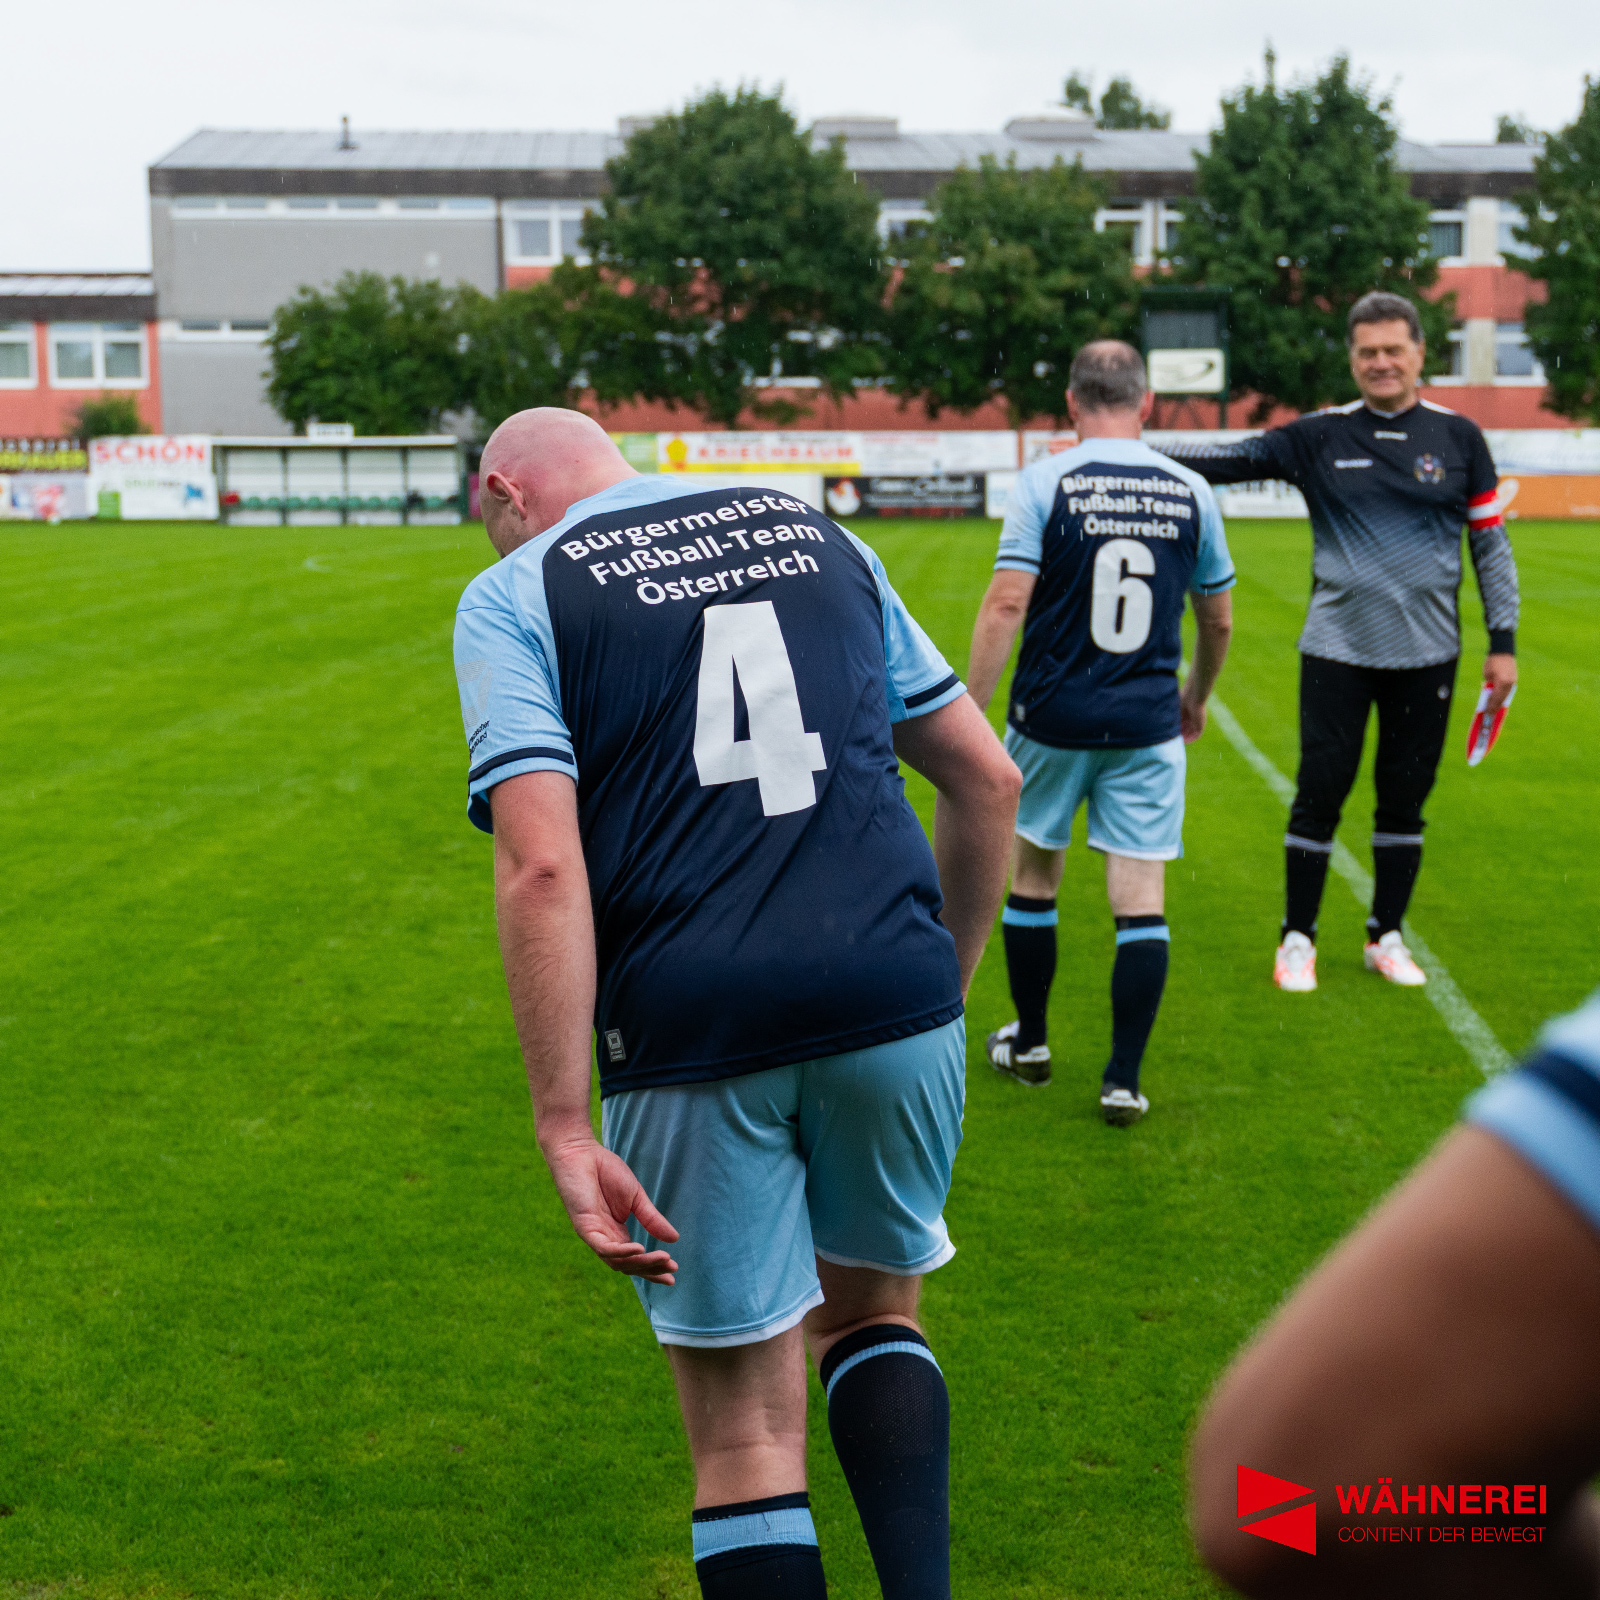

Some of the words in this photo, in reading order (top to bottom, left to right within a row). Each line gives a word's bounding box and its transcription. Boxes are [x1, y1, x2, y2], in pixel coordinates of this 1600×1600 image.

[95, 437, 205, 464] SCHÖN
[1061, 474, 1191, 498] Bürgermeister
[1068, 494, 1191, 520] Fußball-Team
[560, 493, 808, 561] Bürgermeister
[588, 523, 825, 586] Fußball-Team
[1083, 513, 1179, 541] Österreich
[636, 550, 819, 605] Österreich
[1090, 538, 1156, 654] 6
[693, 600, 827, 817] 4
